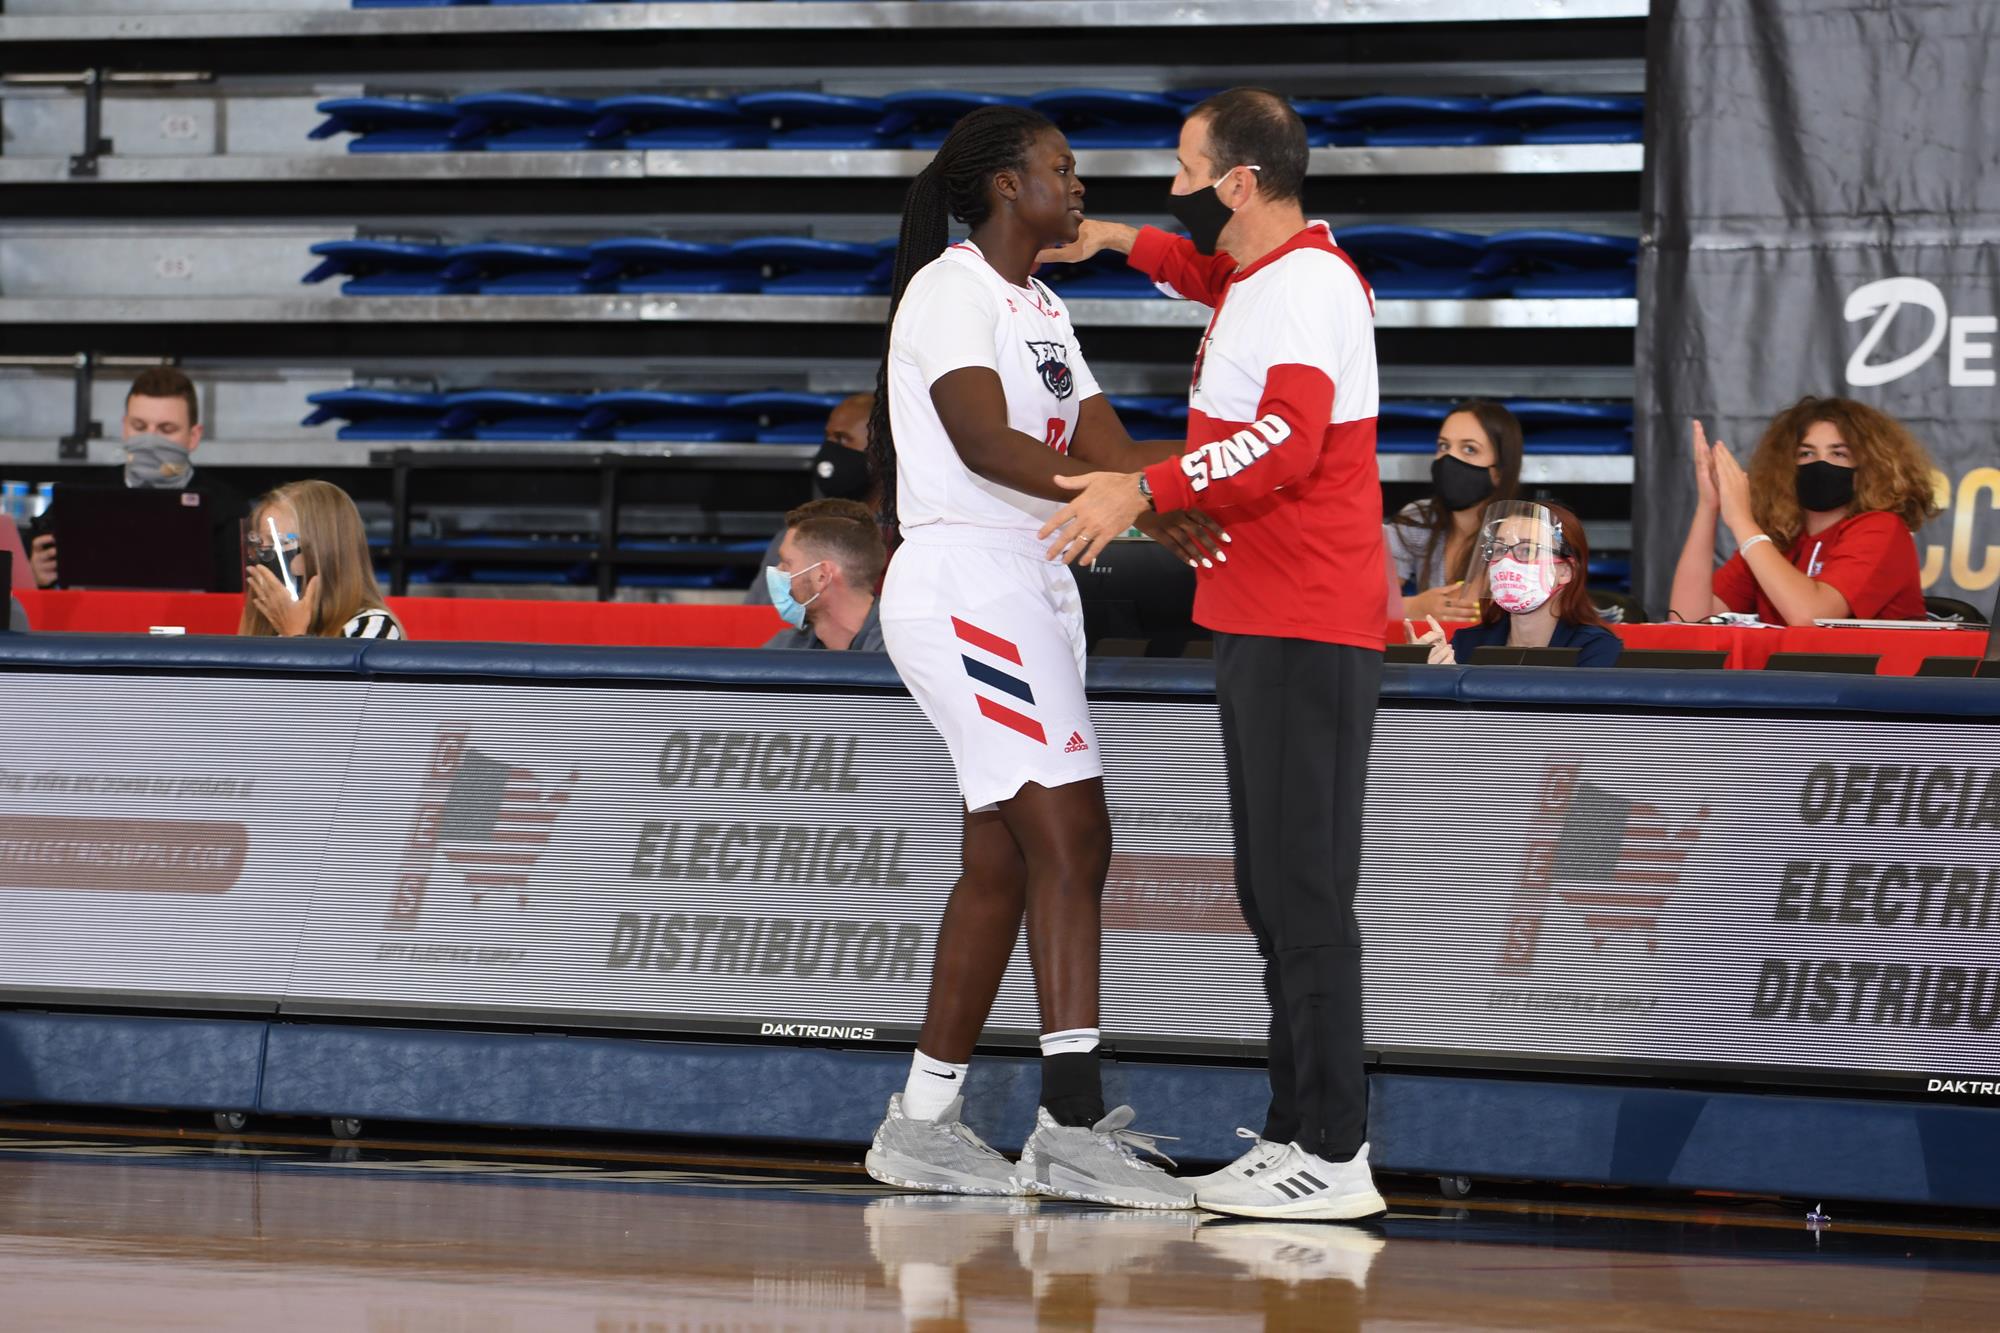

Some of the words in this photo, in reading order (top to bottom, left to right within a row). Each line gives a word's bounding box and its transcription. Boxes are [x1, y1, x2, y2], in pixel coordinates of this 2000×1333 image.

[656, 729, 861, 793] OFFICIAL
[1801, 761, 2000, 830] OFFICIA
[630, 820, 909, 888] ELECTRICAL
[607, 910, 923, 983] DISTRIBUTOR
[760, 1022, 875, 1040] DAKTRONICS
